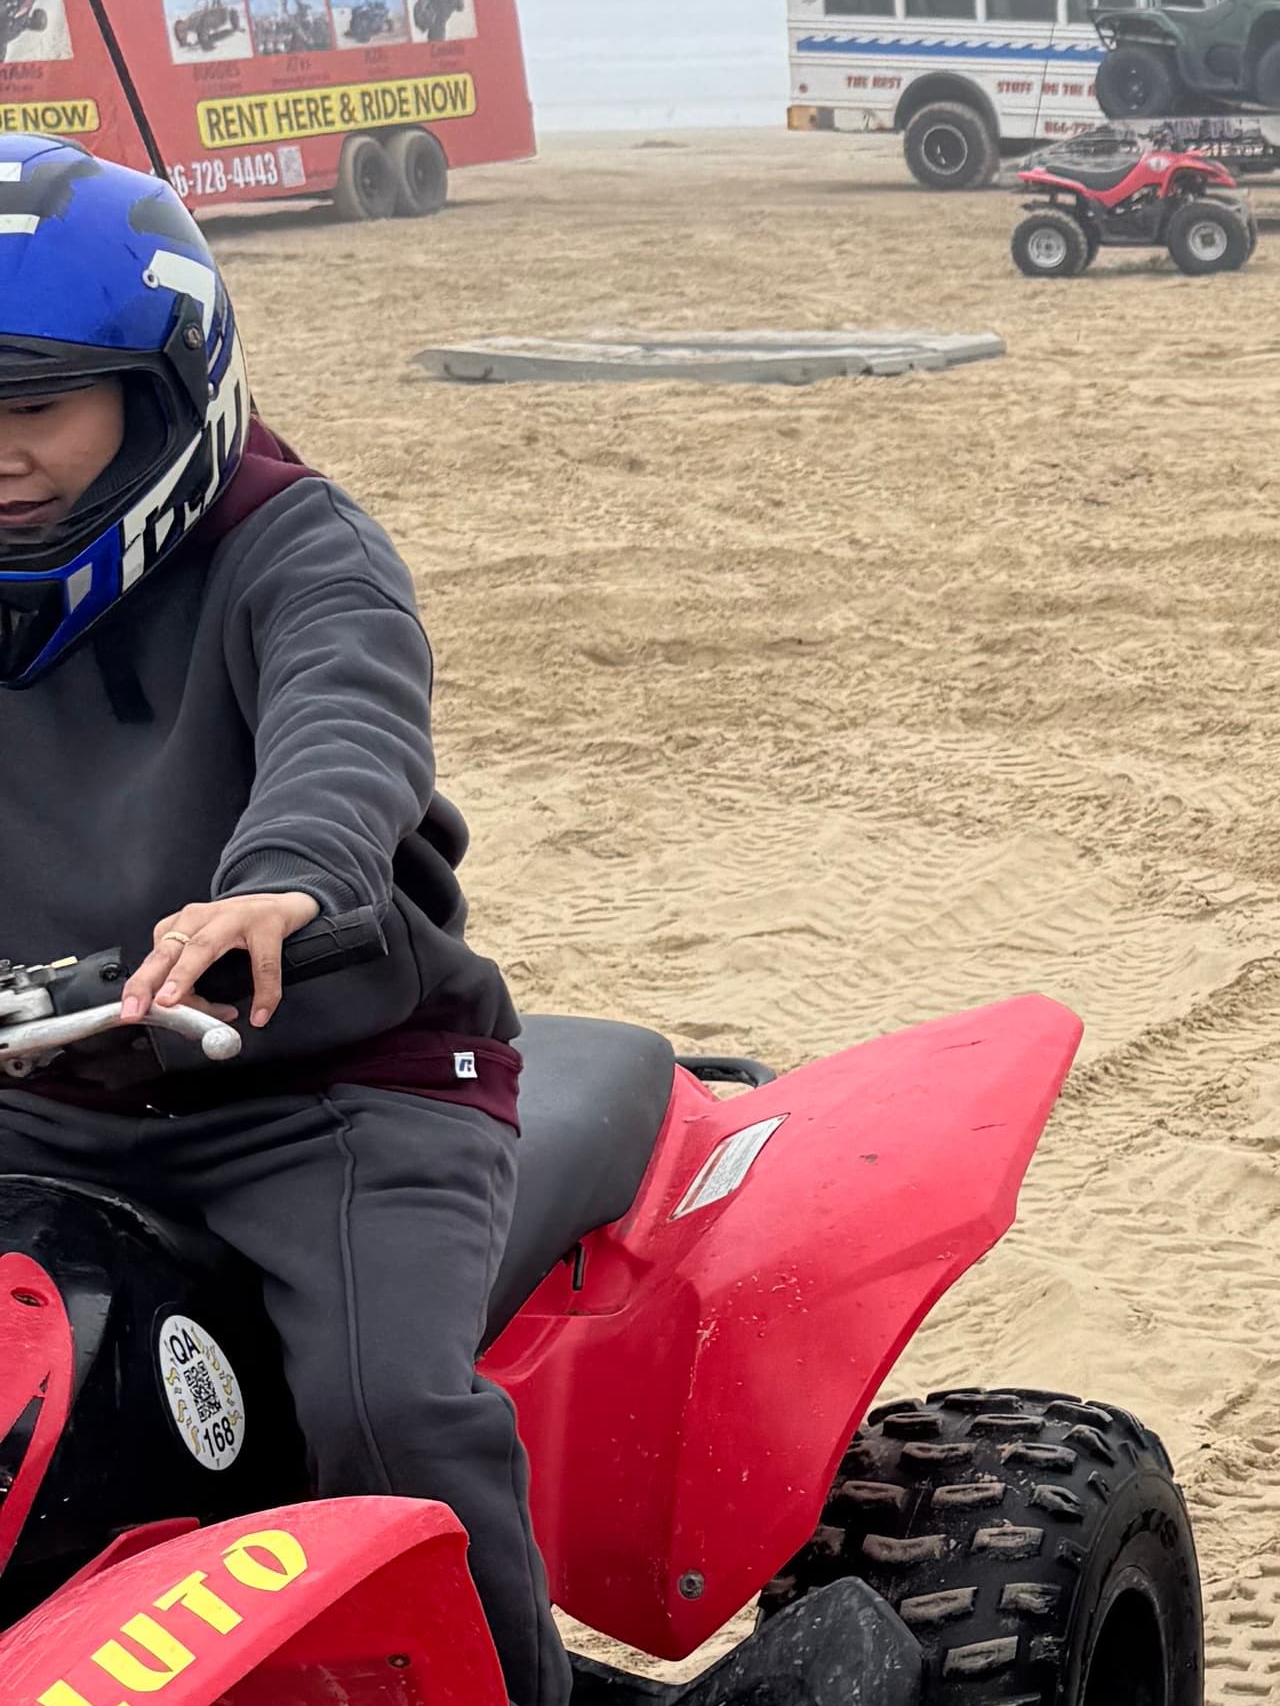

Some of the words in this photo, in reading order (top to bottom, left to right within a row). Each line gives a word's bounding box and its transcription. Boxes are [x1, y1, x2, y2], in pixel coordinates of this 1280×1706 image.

[22, 104, 89, 132] NOW
[207, 102, 269, 142] RENT
[276, 94, 335, 133] HERE
[339, 92, 357, 124] &
[362, 86, 409, 122] RIDE
[415, 80, 468, 116] NOW
[169, 1328, 201, 1366] QA
[204, 1416, 235, 1459] 168
